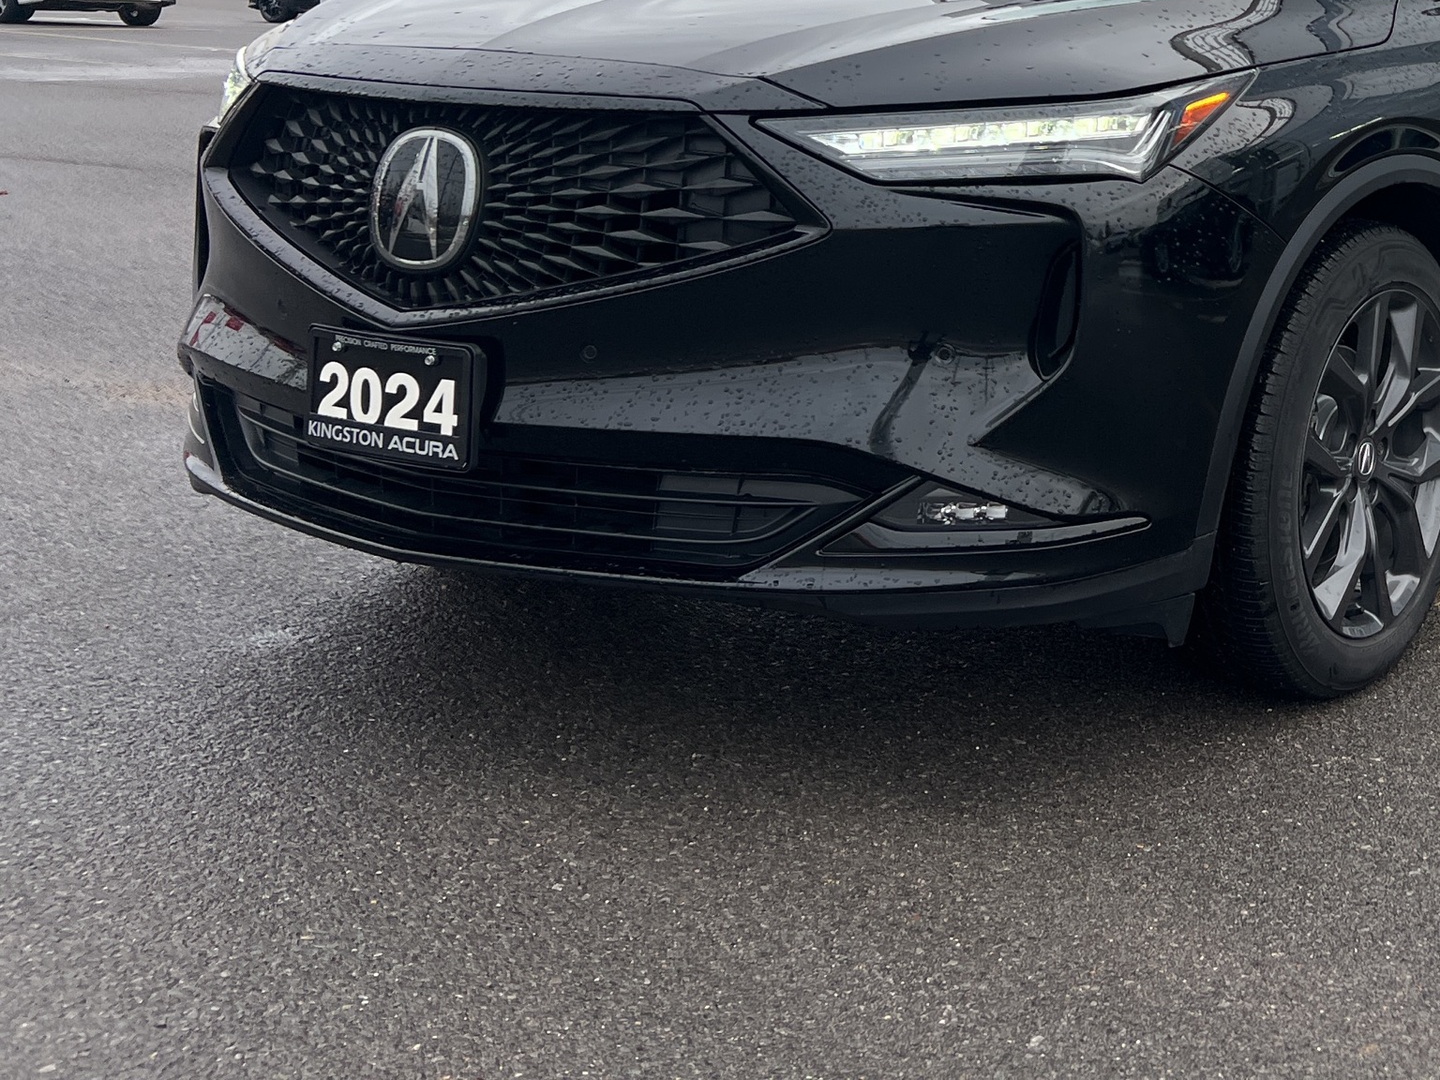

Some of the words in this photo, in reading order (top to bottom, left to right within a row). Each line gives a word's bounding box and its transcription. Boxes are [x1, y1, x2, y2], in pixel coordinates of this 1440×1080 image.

[317, 361, 458, 436] 2024
[307, 420, 384, 448] KINGSTON
[387, 435, 459, 461] ACURA
